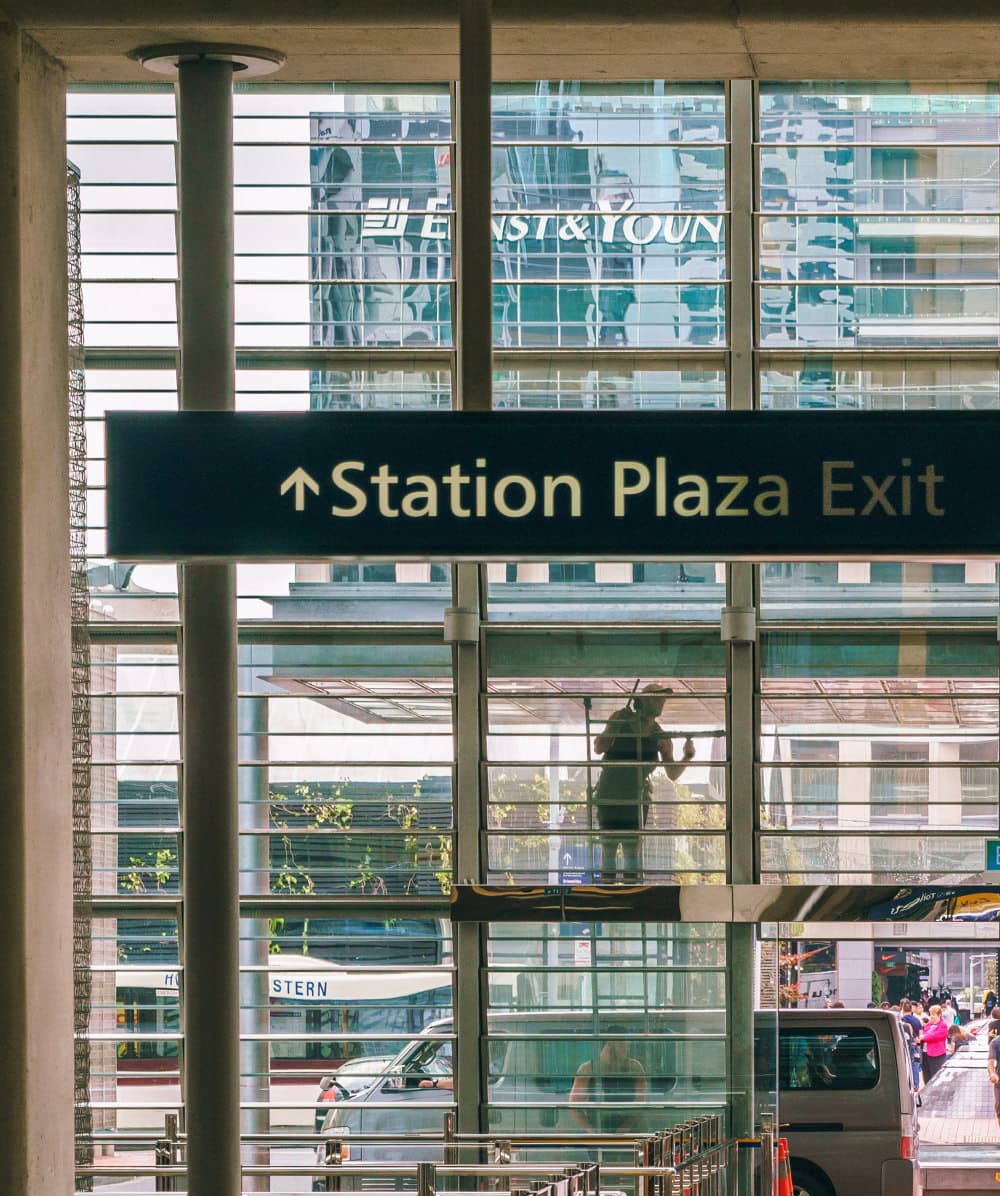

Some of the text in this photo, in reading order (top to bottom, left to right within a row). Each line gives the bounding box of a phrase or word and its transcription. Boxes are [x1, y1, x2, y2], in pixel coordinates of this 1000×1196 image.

[597, 199, 723, 244] YOUN
[330, 457, 947, 518] Station Plaza Exit
